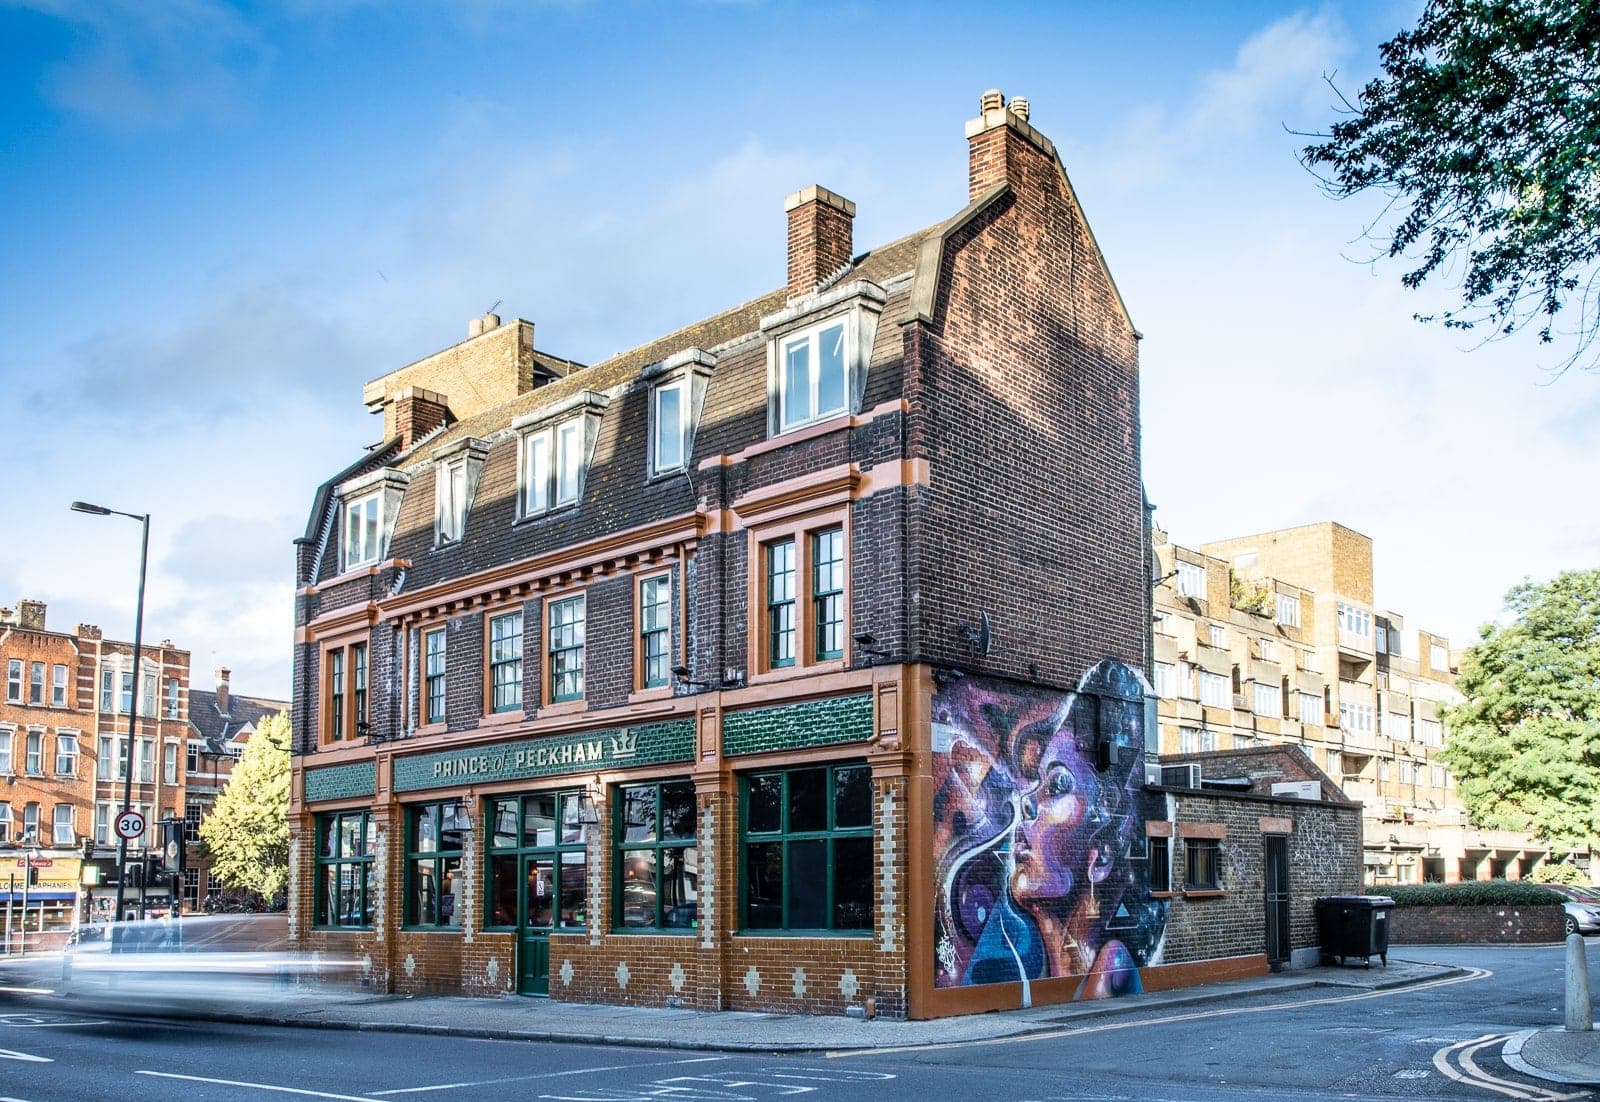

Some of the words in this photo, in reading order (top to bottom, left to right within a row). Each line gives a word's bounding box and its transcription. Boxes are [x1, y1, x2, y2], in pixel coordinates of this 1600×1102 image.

[434, 757, 487, 776] PRINCE
[493, 751, 506, 776] of
[516, 742, 602, 767] PECKHAM
[121, 819, 142, 831] 30
